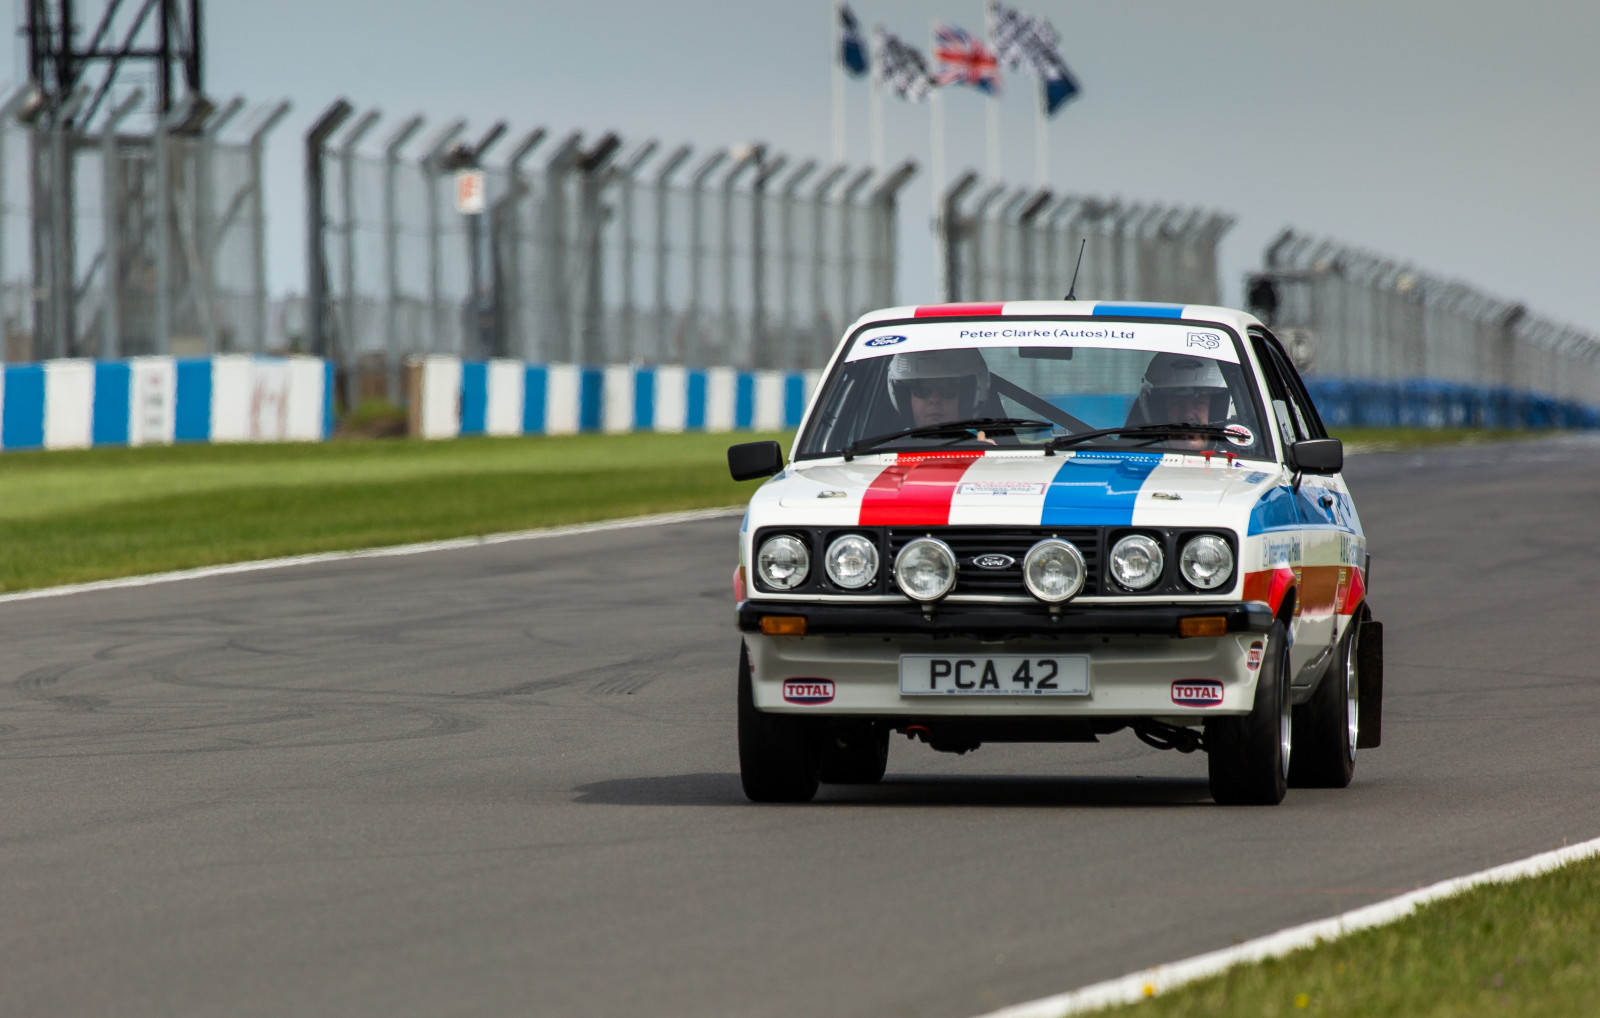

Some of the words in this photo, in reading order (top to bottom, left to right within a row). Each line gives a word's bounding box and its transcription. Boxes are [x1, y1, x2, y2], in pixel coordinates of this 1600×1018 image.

[959, 330, 999, 339] Peter
[1002, 329, 1051, 338] Clarke
[1053, 328, 1108, 338] (Autos)
[1111, 330, 1135, 339] Ltd
[870, 336, 901, 346] Ford
[1186, 331, 1220, 350] RS
[930, 659, 1000, 690] PCA
[1012, 659, 1058, 690] 42
[786, 684, 830, 697] TOTAL
[1174, 686, 1219, 699] TOTAL
